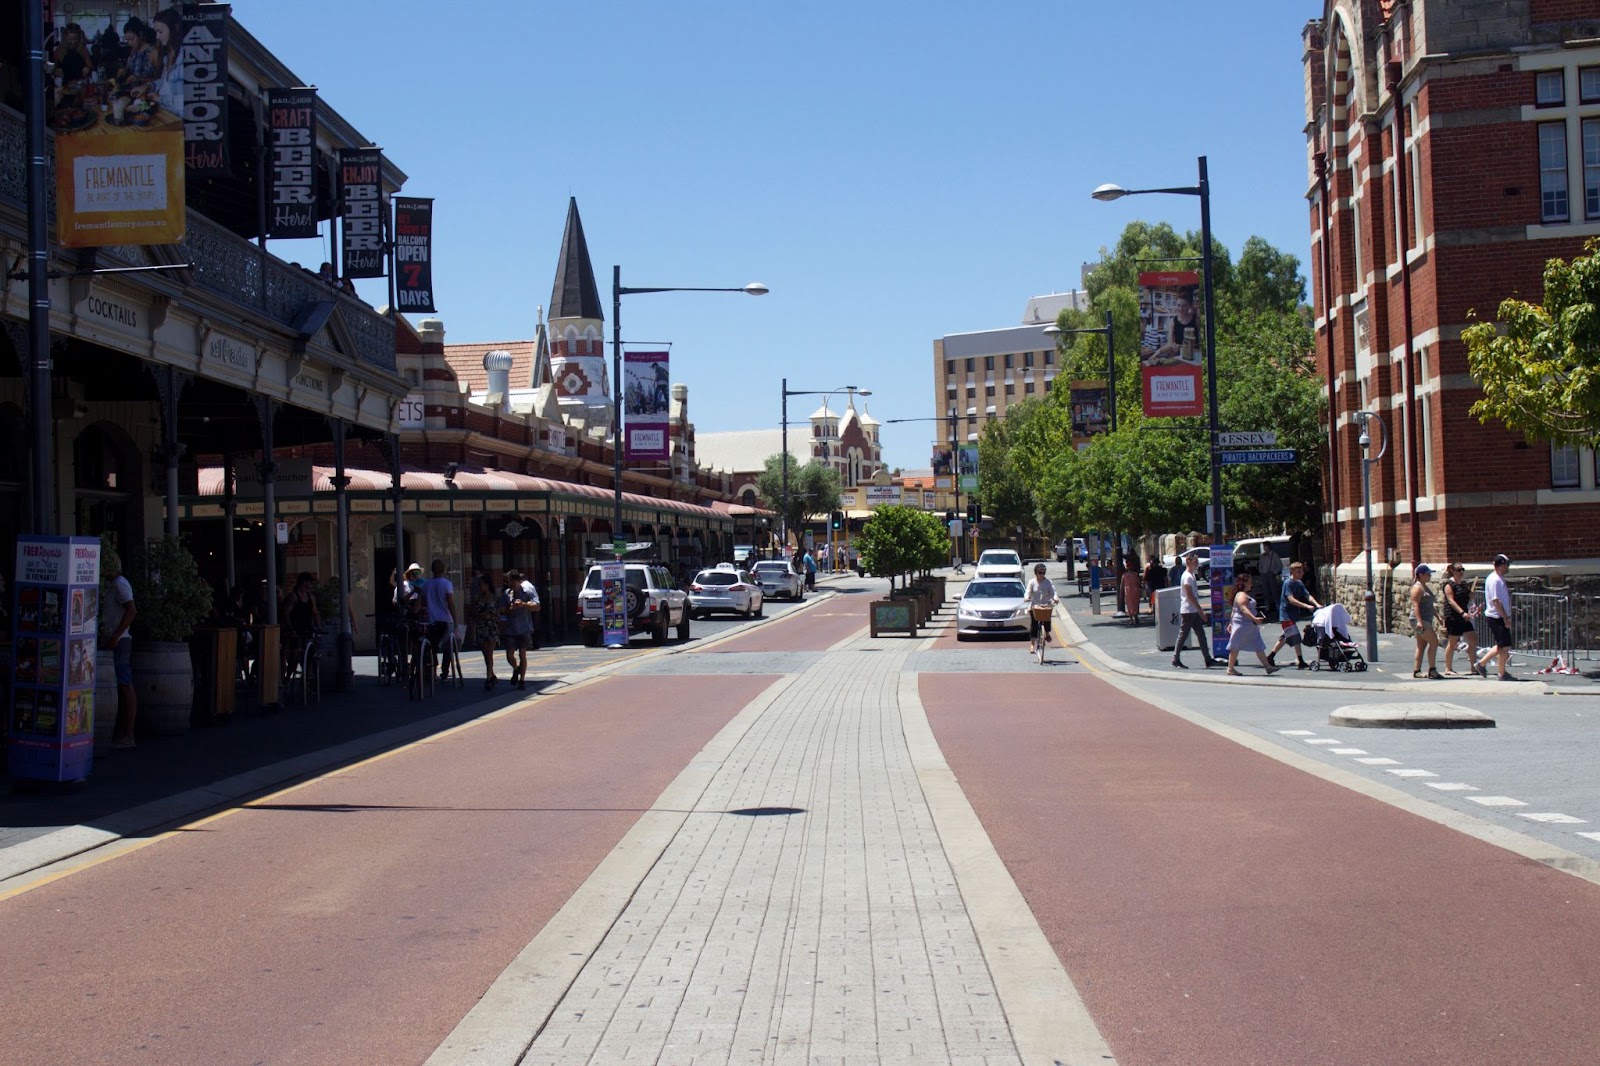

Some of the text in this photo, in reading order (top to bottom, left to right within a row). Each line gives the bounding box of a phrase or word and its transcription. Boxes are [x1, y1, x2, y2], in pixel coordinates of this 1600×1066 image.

[182, 25, 224, 141] ANCHOR
[272, 108, 312, 128] CRAFT
[273, 128, 316, 204] BEER
[343, 165, 379, 184] ENJOY
[86, 164, 155, 189] FREMANTLE
[275, 205, 312, 227] Here!
[345, 184, 383, 251] BEER
[397, 235, 428, 246] BALCONY
[347, 250, 380, 269] Here!
[398, 246, 428, 262] OPEN
[402, 264, 422, 287] 7
[399, 289, 430, 306] DAYS
[88, 296, 137, 328] COCKTAILS
[1156, 379, 1190, 391] FREMANTLE
[398, 401, 423, 421] ETS
[1228, 434, 1265, 444] ESSEX
[1222, 451, 1289, 462] PIRATES BACKPACKERS
[276, 473, 309, 482] anchor
[23, 546, 39, 557] FRED
